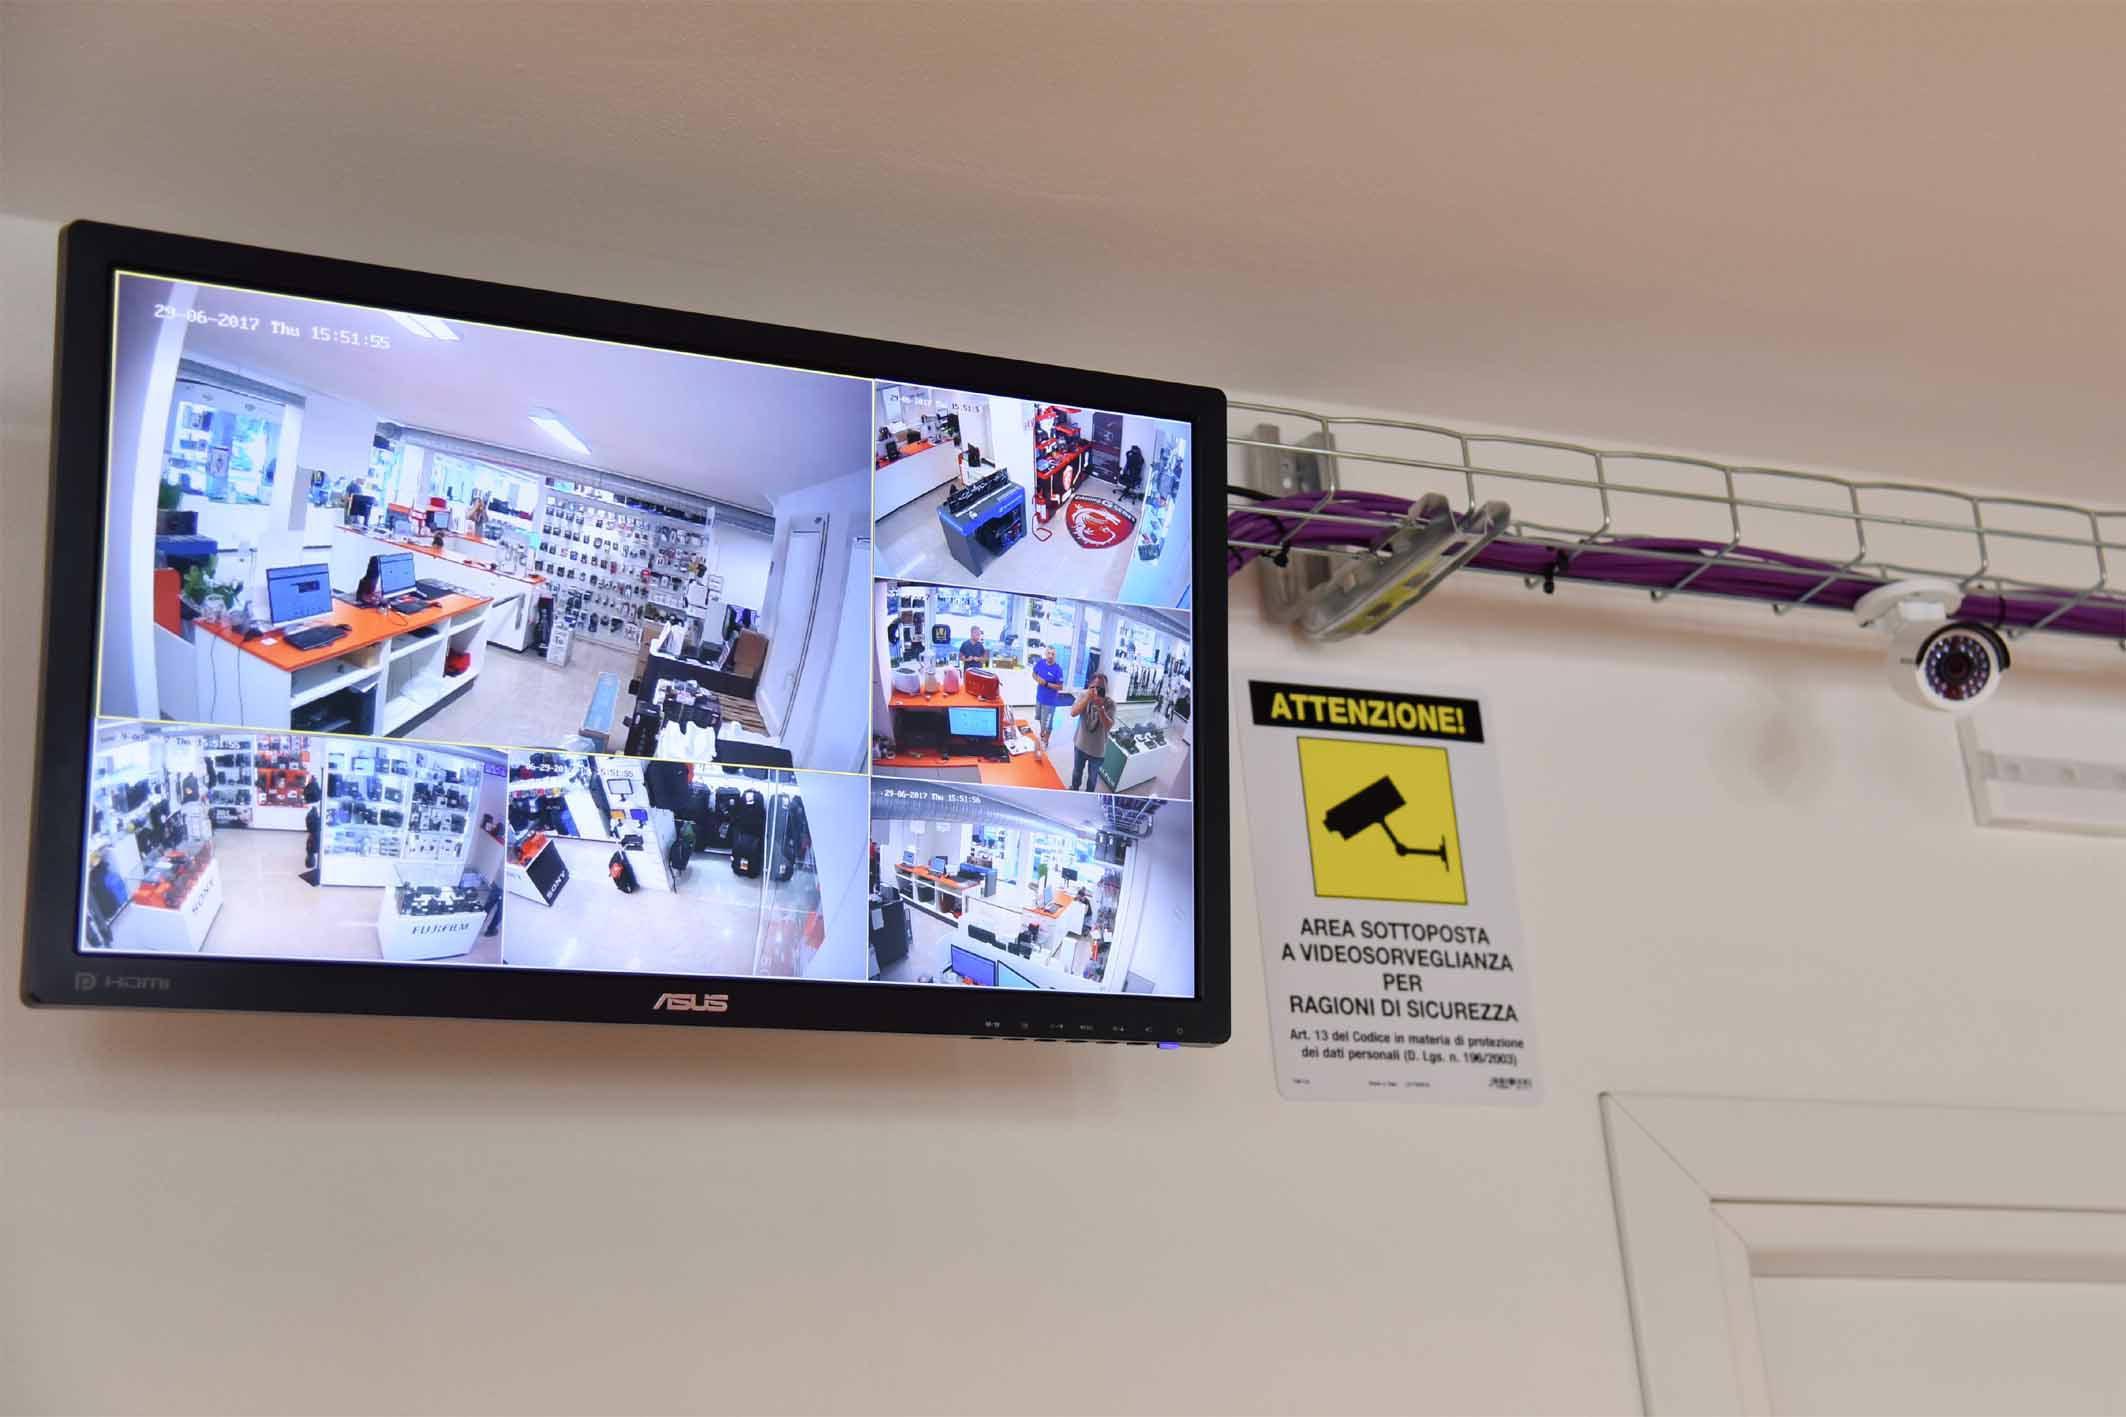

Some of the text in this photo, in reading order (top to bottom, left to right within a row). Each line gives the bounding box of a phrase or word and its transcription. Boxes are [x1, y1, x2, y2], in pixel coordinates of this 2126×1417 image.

[271, 320, 300, 337] Thu
[311, 325, 391, 350] 15:51:55
[1270, 692, 1466, 735] ATTENZIONE!
[1300, 918, 1490, 945] AREA SOTTOPOSTA
[1281, 942, 1514, 972] A VIDEOSORVEGLIANZA
[1382, 973, 1423, 992] PER
[653, 992, 729, 1012] ASUS
[1290, 995, 1519, 1022] RAGIONI DI SICUREZZA
[1290, 1028, 1525, 1048] Art. 13 del Codice in materia di protezione
[1302, 1046, 1319, 1058] dei
[1323, 1047, 1344, 1058] dati
[1348, 1049, 1400, 1061] personali
[1404, 1049, 1419, 1063] (D.
[1422, 1050, 1445, 1064] Lgs.
[1449, 1053, 1459, 1061] n.
